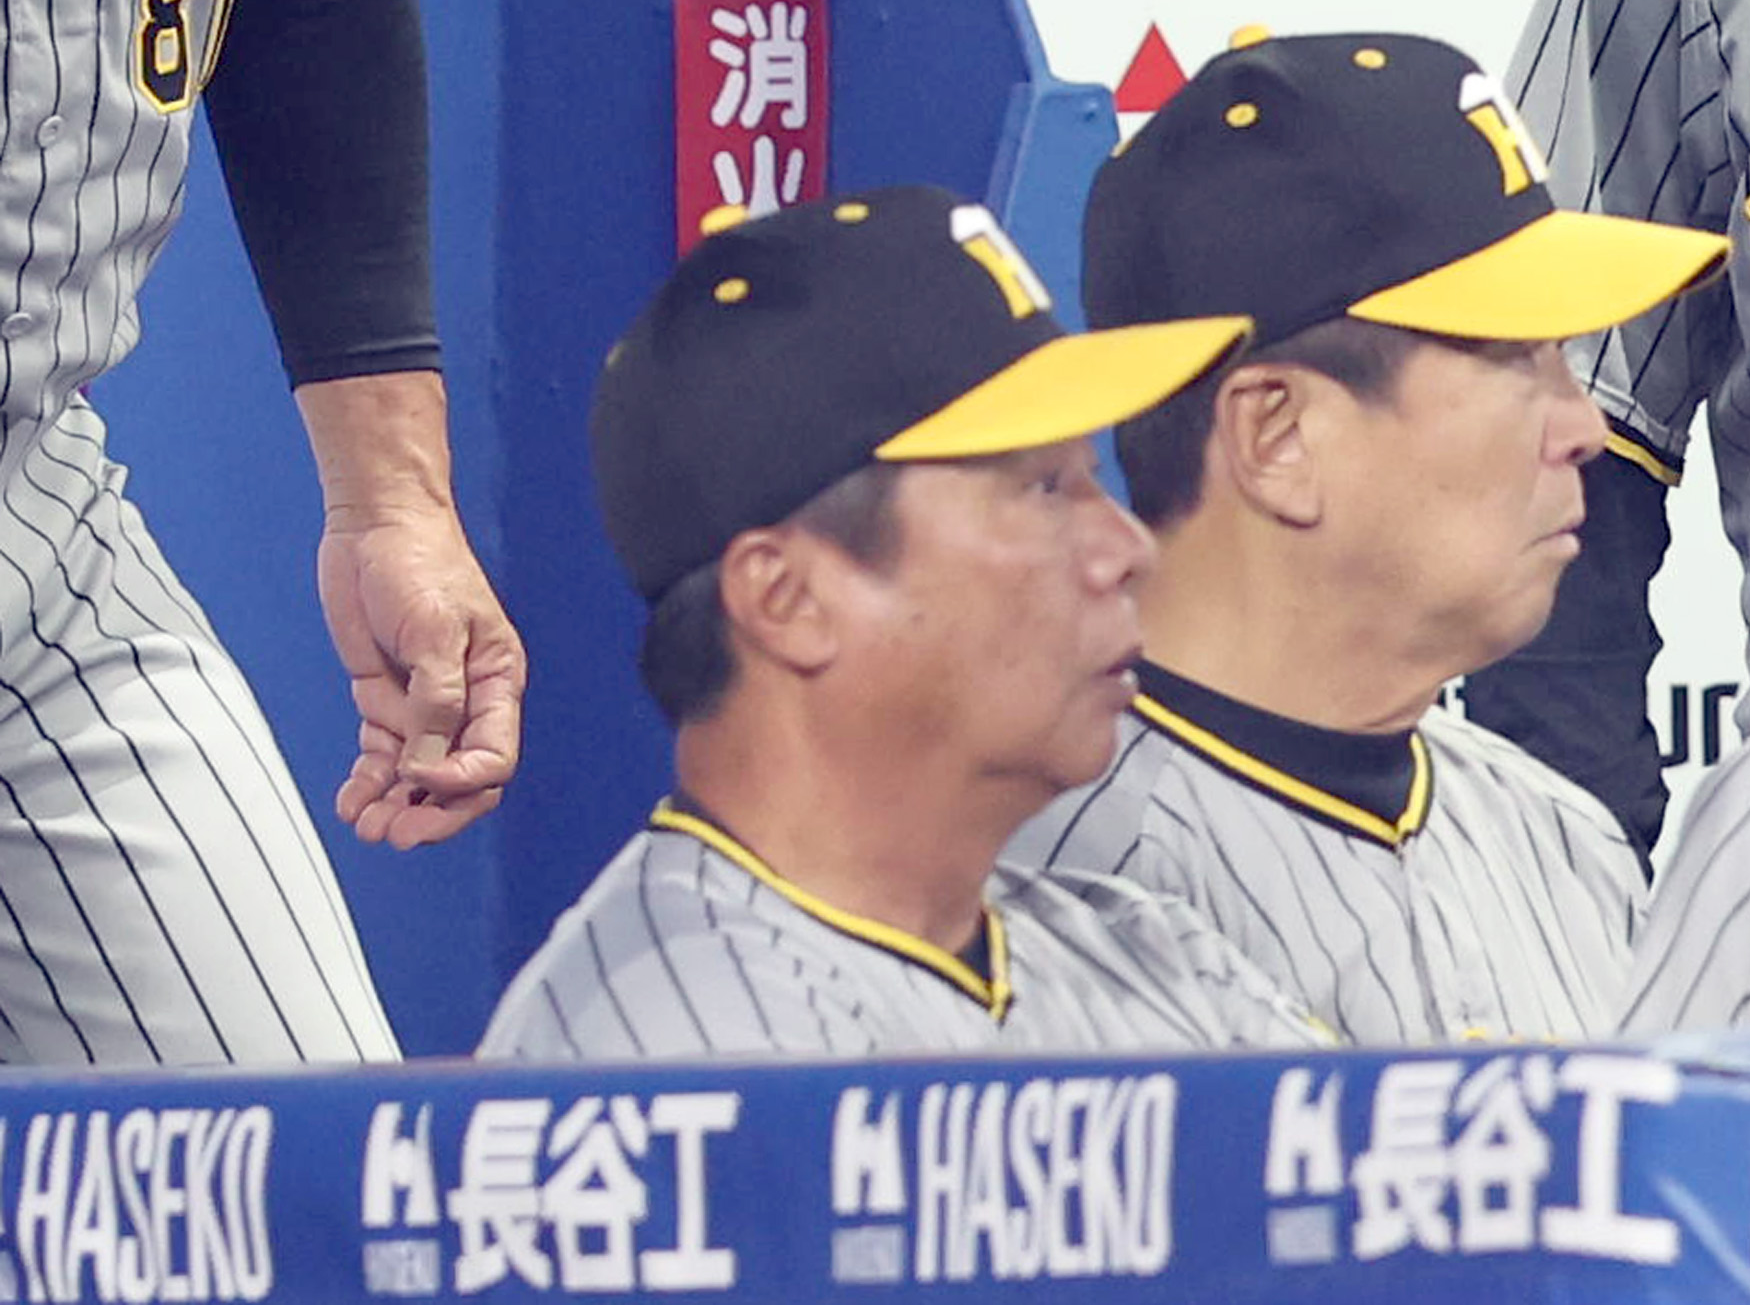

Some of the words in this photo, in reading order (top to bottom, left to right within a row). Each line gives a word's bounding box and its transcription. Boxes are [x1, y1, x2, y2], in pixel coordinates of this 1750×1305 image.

[17, 1106, 274, 1303] HASEKO
[446, 1092, 740, 1294] 長谷工
[915, 1072, 1177, 1282] HASEKO
[1350, 1052, 1681, 1265] 長谷工
